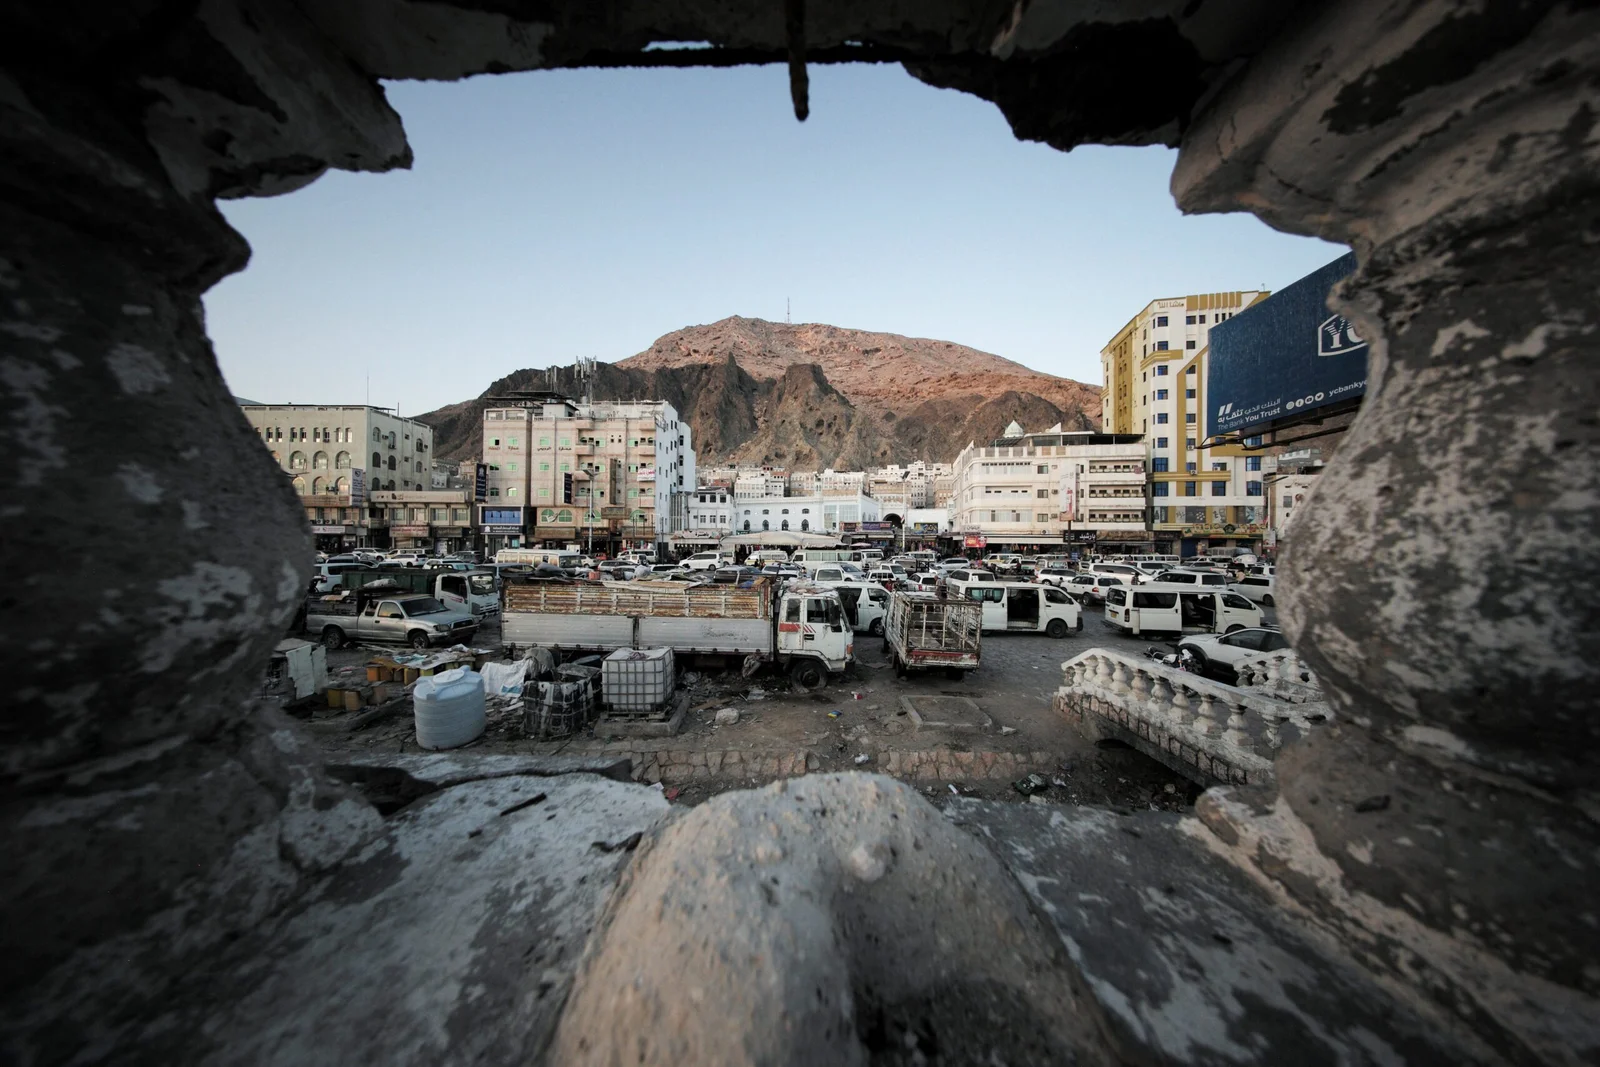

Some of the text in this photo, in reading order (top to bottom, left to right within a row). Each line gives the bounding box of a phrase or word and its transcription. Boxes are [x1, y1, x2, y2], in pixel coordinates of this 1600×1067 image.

[1217, 398, 1281, 424] البنك الذي تثق به
[1218, 407, 1281, 431] The Bank You Trust
